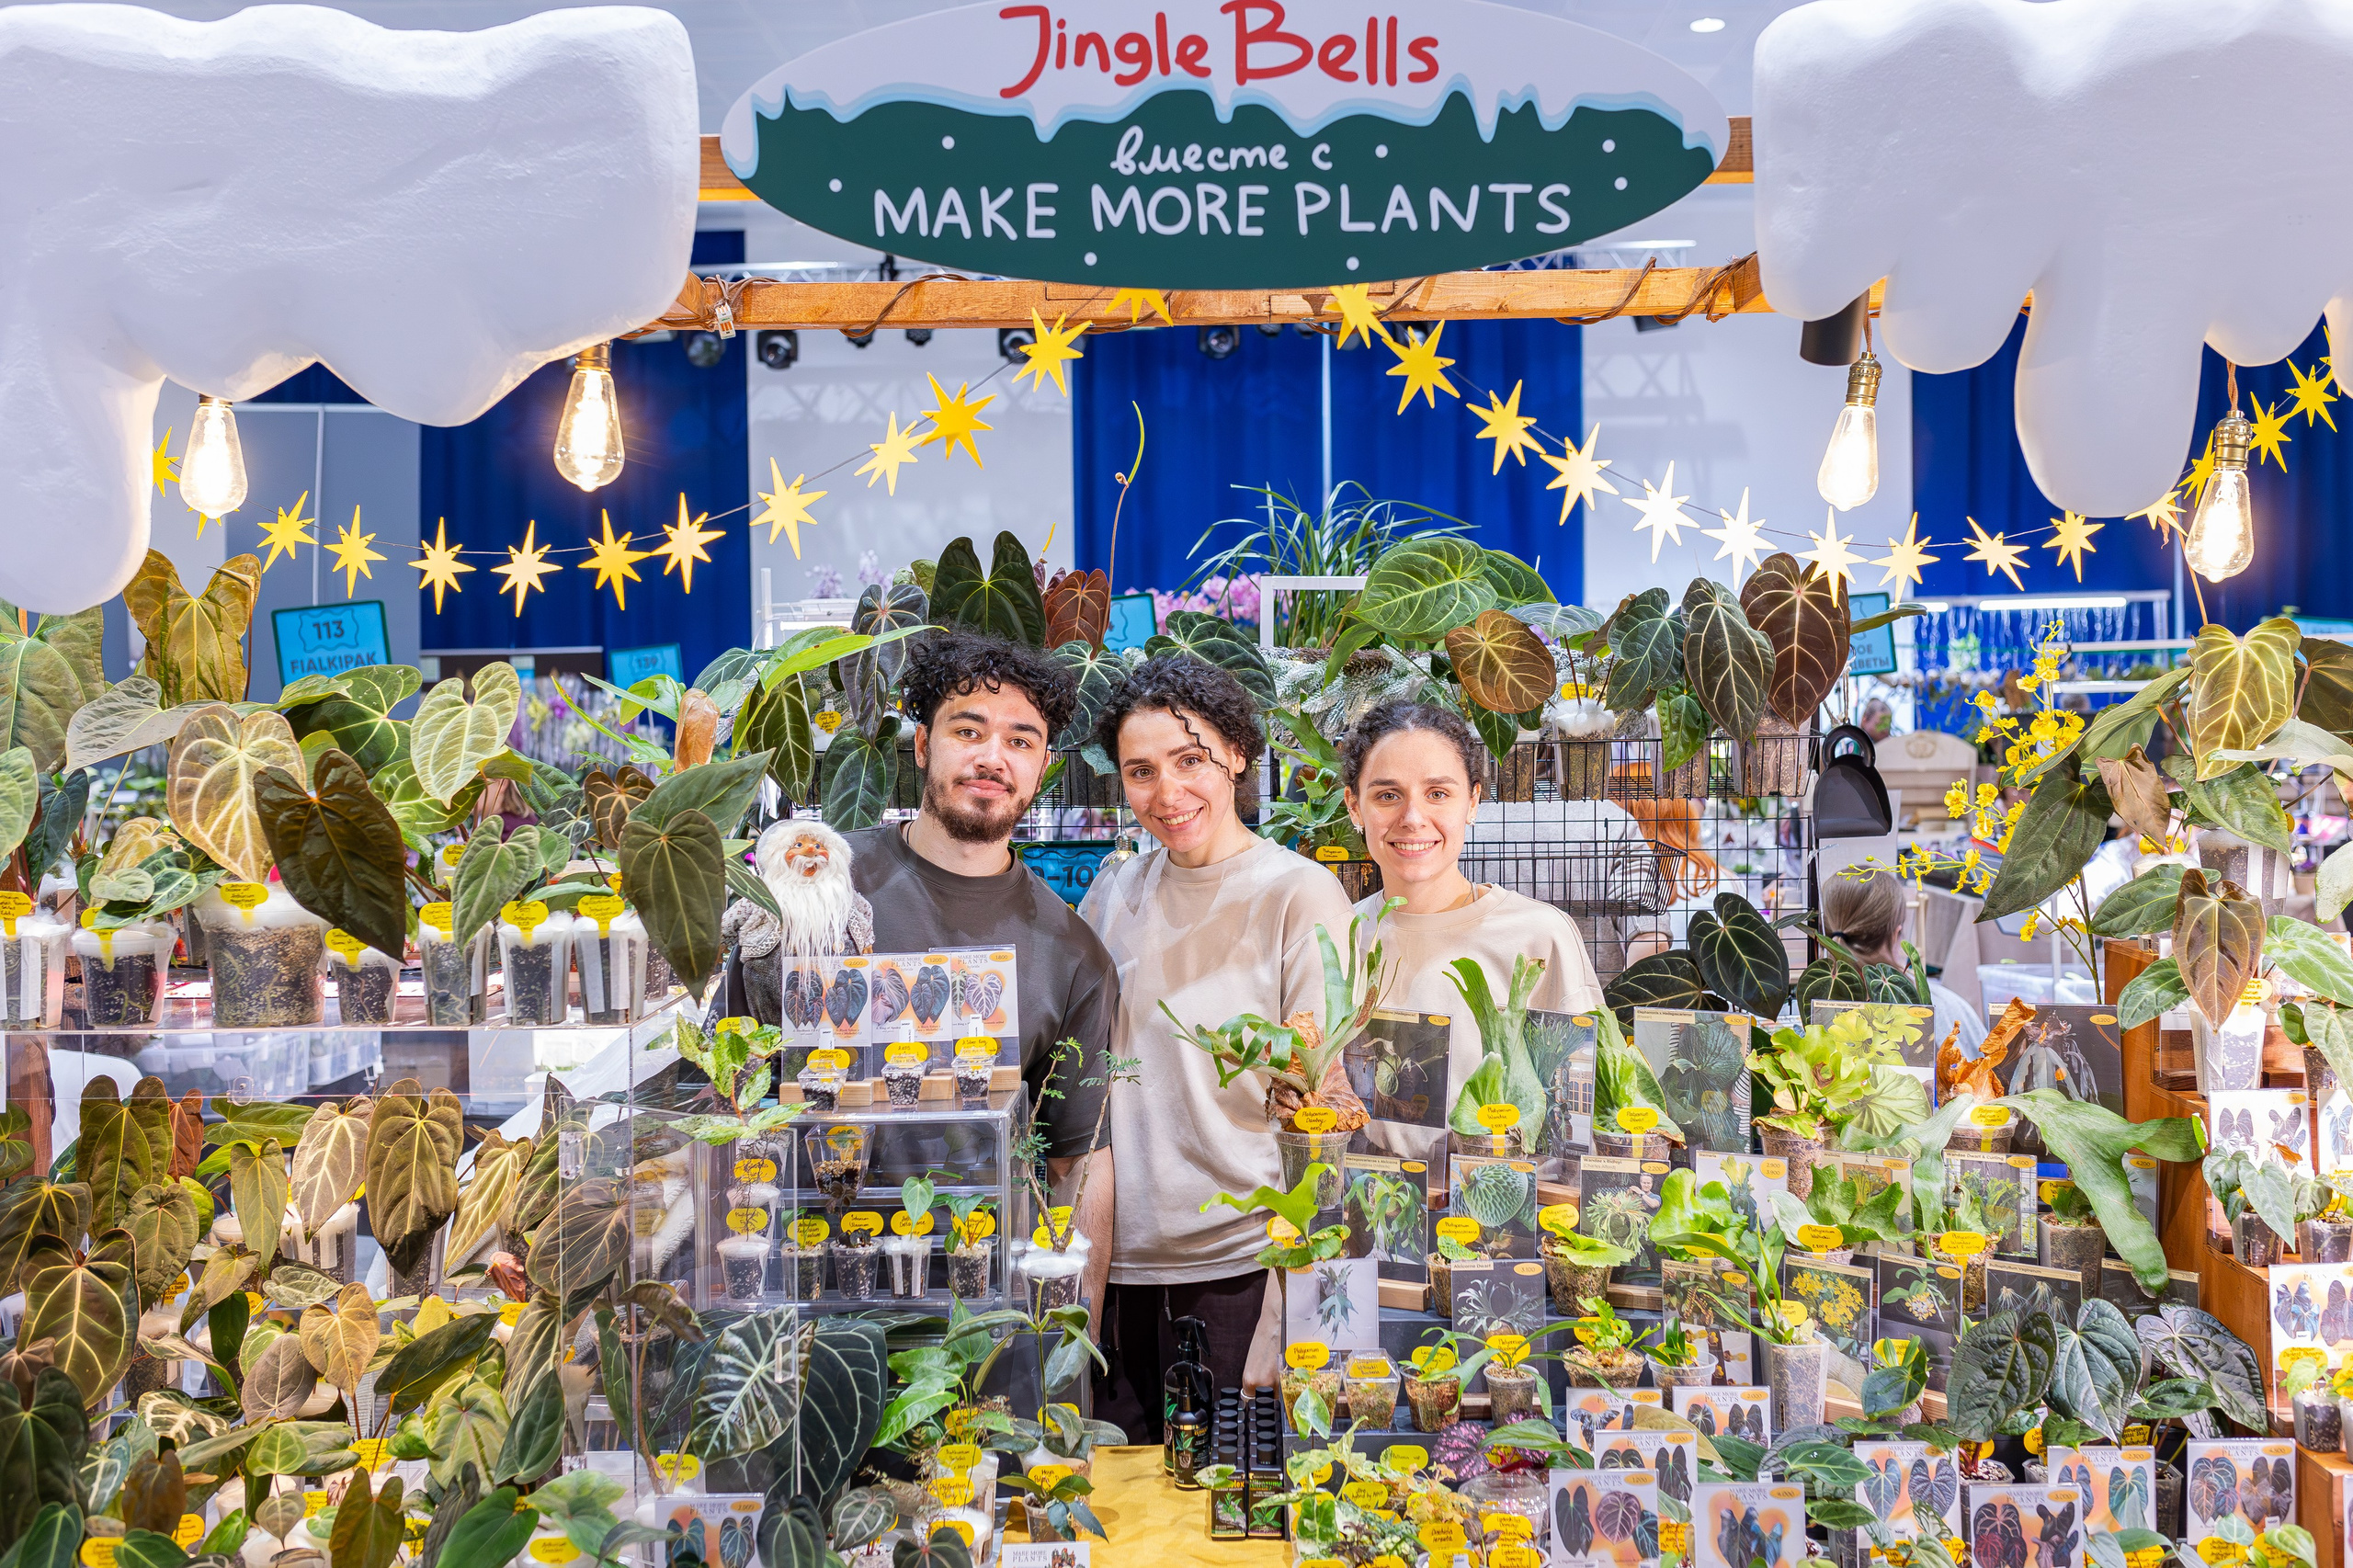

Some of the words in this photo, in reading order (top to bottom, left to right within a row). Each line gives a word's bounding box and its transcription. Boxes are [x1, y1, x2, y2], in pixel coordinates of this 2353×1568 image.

[999, 6, 1211, 98] Jingle
[1220, 0, 1438, 86] Bells
[1110, 125, 1290, 176] вместе
[1312, 142, 1333, 171] с
[874, 183, 1059, 241] MAKE
[1091, 182, 1269, 237] MORE
[1295, 181, 1572, 236] PLANTS
[313, 620, 345, 640] 113
[290, 652, 377, 674] FIALKIPAK
